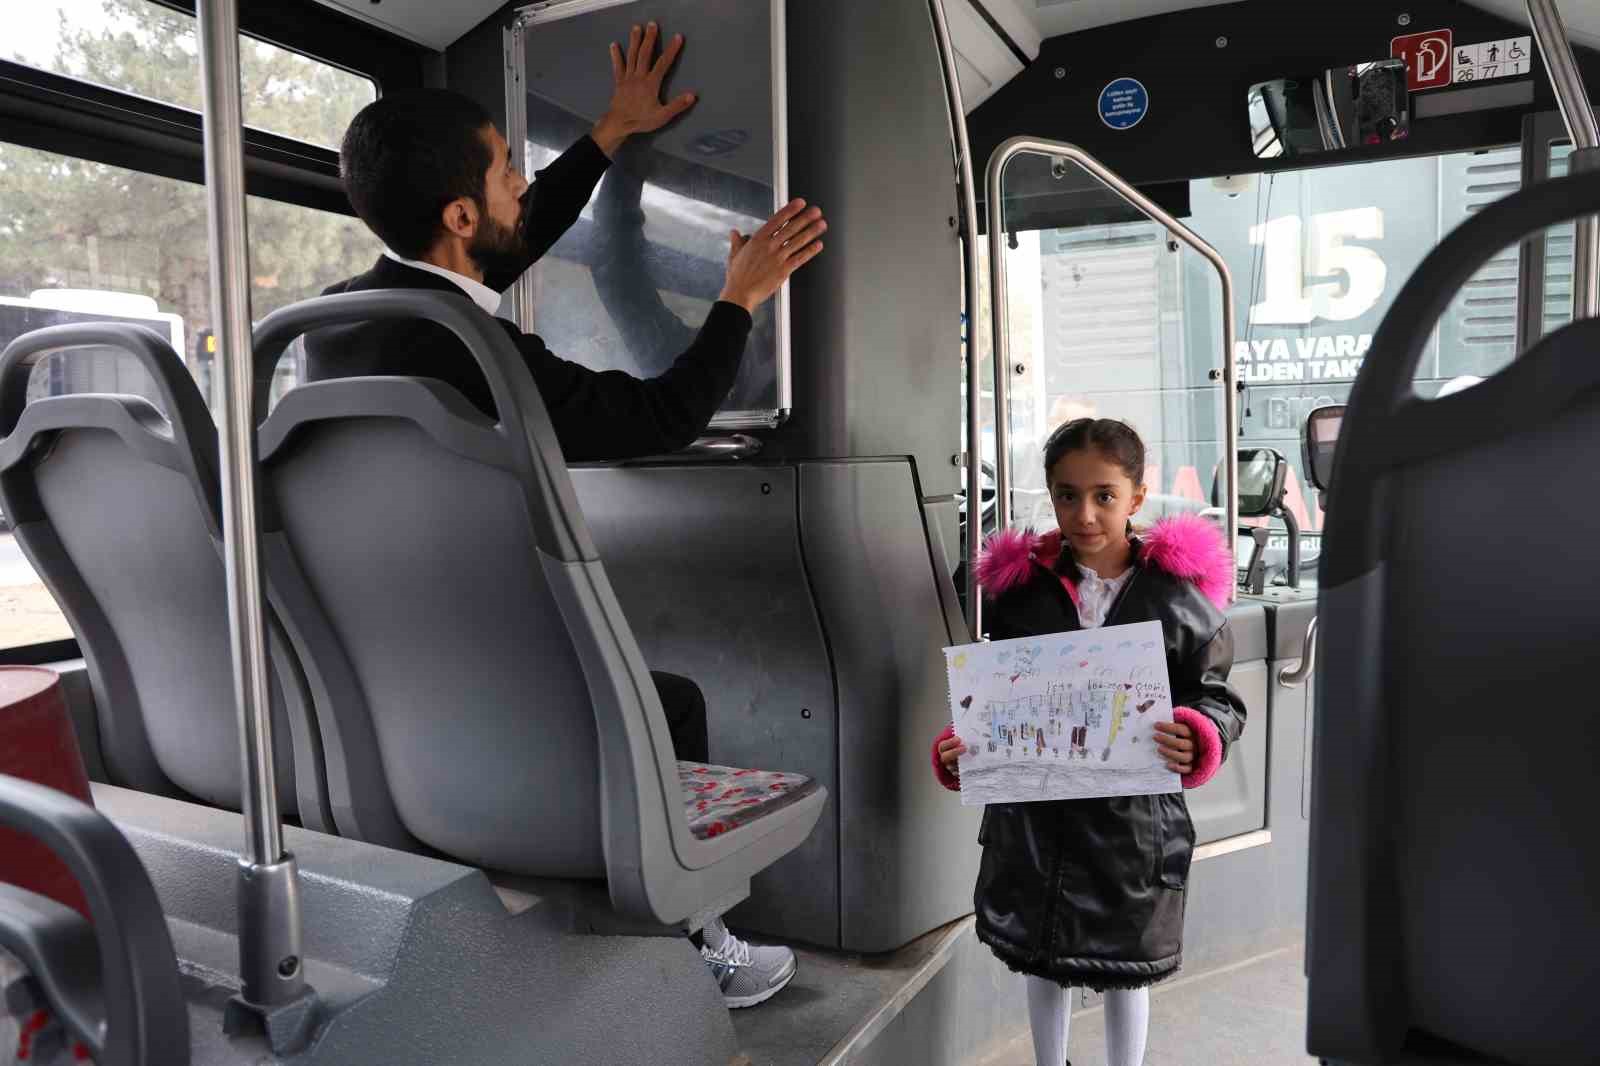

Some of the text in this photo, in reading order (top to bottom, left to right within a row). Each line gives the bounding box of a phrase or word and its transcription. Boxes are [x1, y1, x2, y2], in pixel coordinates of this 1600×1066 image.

[1457, 62, 1519, 81] 26 77 1
[1248, 206, 1386, 325] 15
[1309, 358, 1364, 379] TAK
